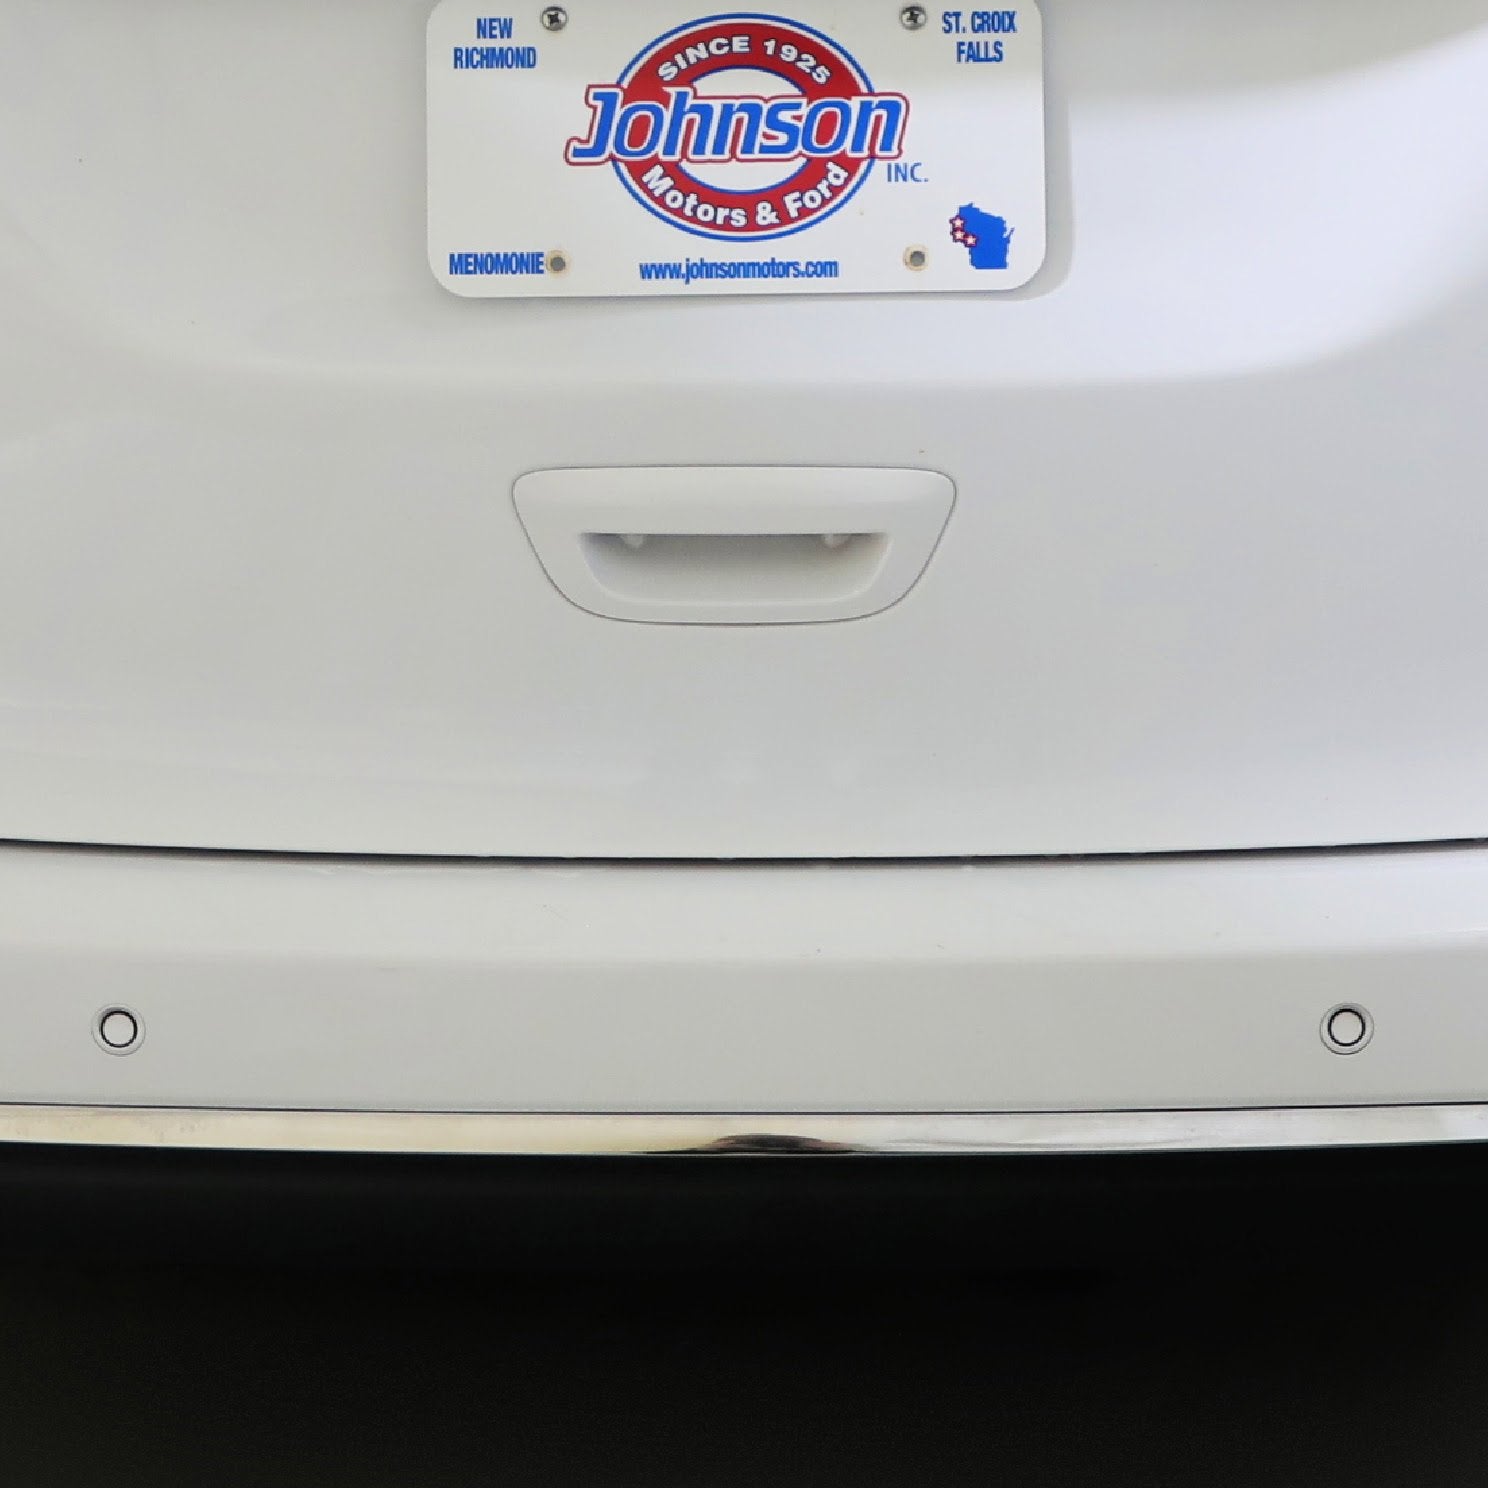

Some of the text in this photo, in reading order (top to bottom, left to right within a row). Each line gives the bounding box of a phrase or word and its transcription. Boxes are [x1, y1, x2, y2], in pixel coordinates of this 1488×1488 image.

[476, 17, 513, 40] NEW
[942, 10, 1017, 34] ST. CROIX
[453, 46, 537, 70] RICHMOND
[657, 34, 832, 85] SINCE 1925
[956, 40, 1004, 63] FALLS
[568, 87, 909, 164] Johnson
[886, 162, 929, 183] INC.
[640, 160, 850, 228] Motors & Ford
[448, 251, 545, 275] MENOMONIE
[638, 257, 839, 285] www.johnsonmotors.com
